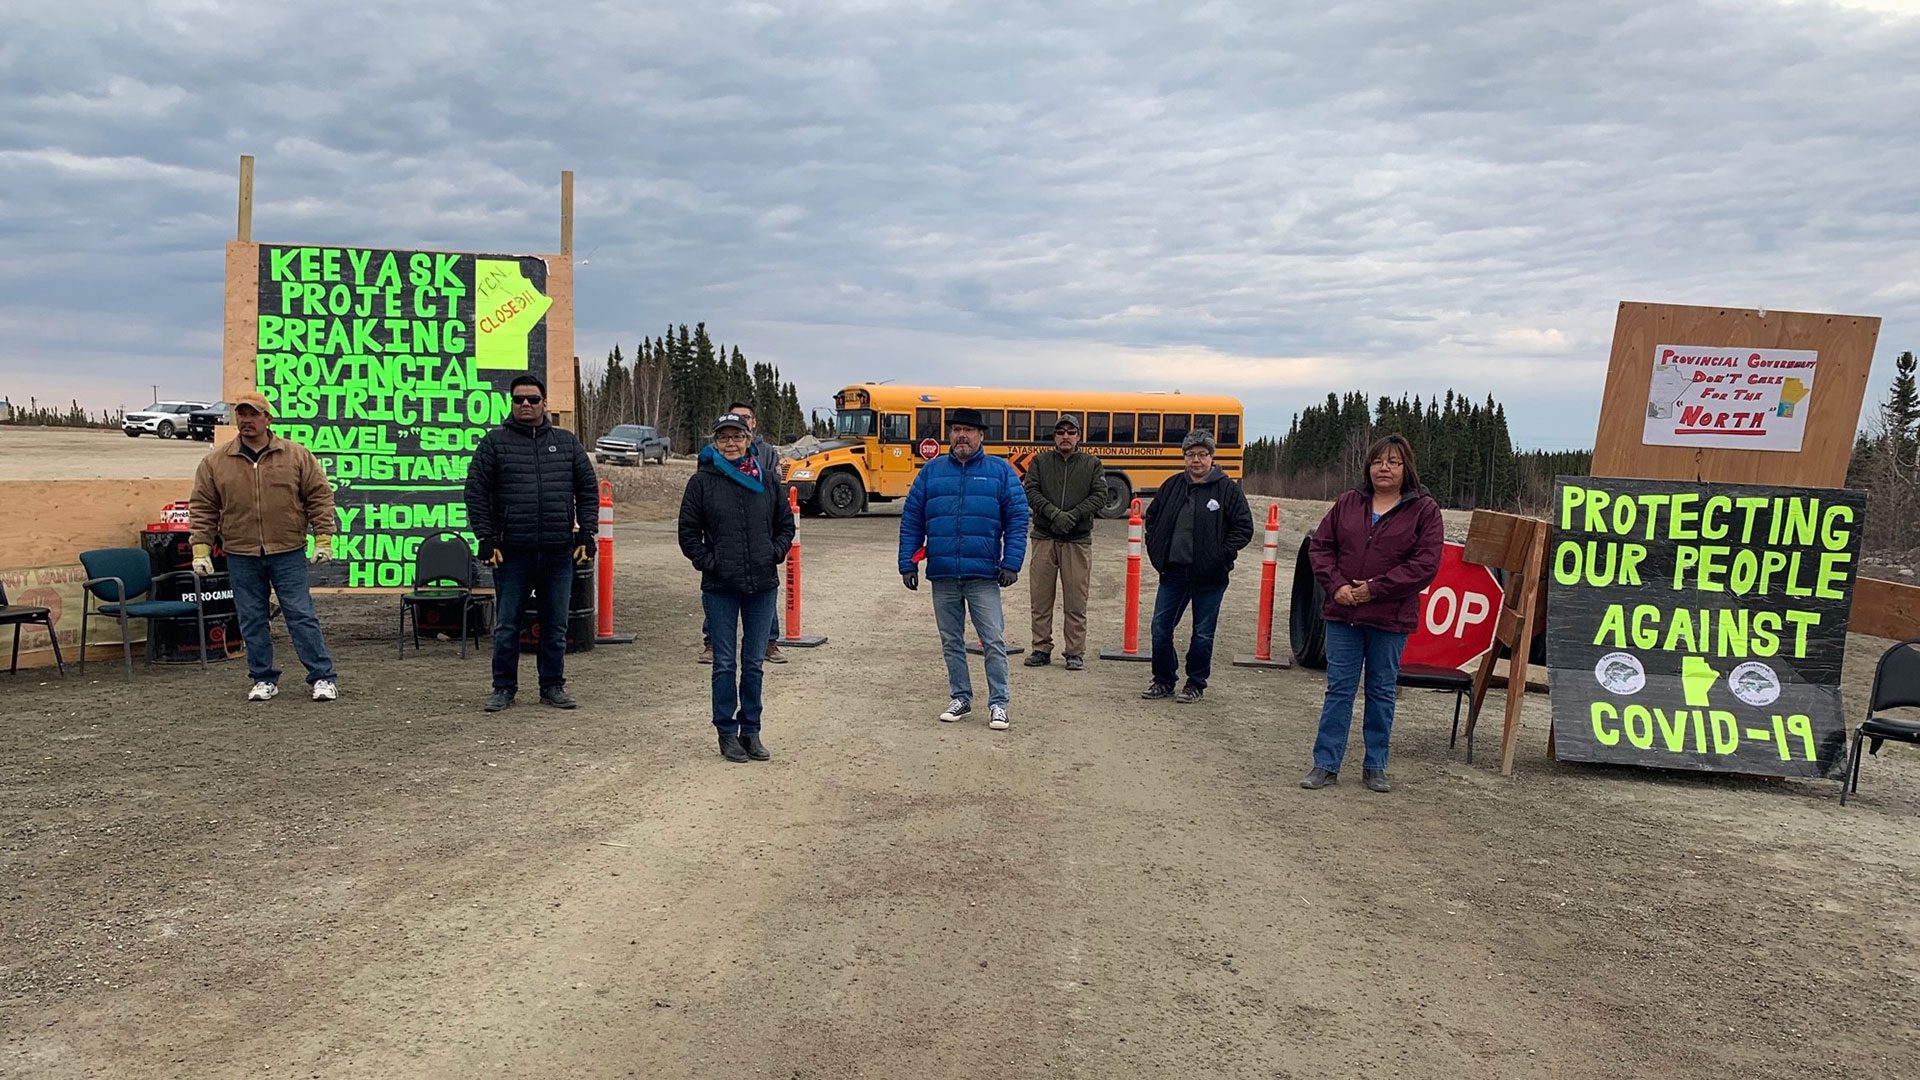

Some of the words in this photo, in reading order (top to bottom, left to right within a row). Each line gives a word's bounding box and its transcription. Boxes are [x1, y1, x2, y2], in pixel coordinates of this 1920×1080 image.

[271, 248, 461, 287] KEEYASK
[477, 266, 507, 297] TCN
[282, 282, 466, 319] PROJECT
[258, 315, 466, 354] BREAKING
[256, 353, 492, 396] PROVINCIAL
[1661, 349, 1738, 367] PROVINCIAL
[1692, 370, 1742, 384] DON'T
[1747, 373, 1783, 385] CARE
[1700, 387, 1728, 400] FOR
[1733, 389, 1763, 401] THE
[922, 444, 937, 454] STOP
[1008, 446, 1056, 455] TATASKWE
[1119, 447, 1164, 455] AUTHORITY
[364, 503, 467, 530] HOME
[1561, 485, 1854, 551] PROTECTING
[1554, 541, 1647, 587] OUR
[1673, 545, 1851, 600] PEOPLE
[1420, 586, 1490, 639] OP
[1593, 604, 1821, 658] AGAINST
[1590, 702, 1817, 761] COVID-19
